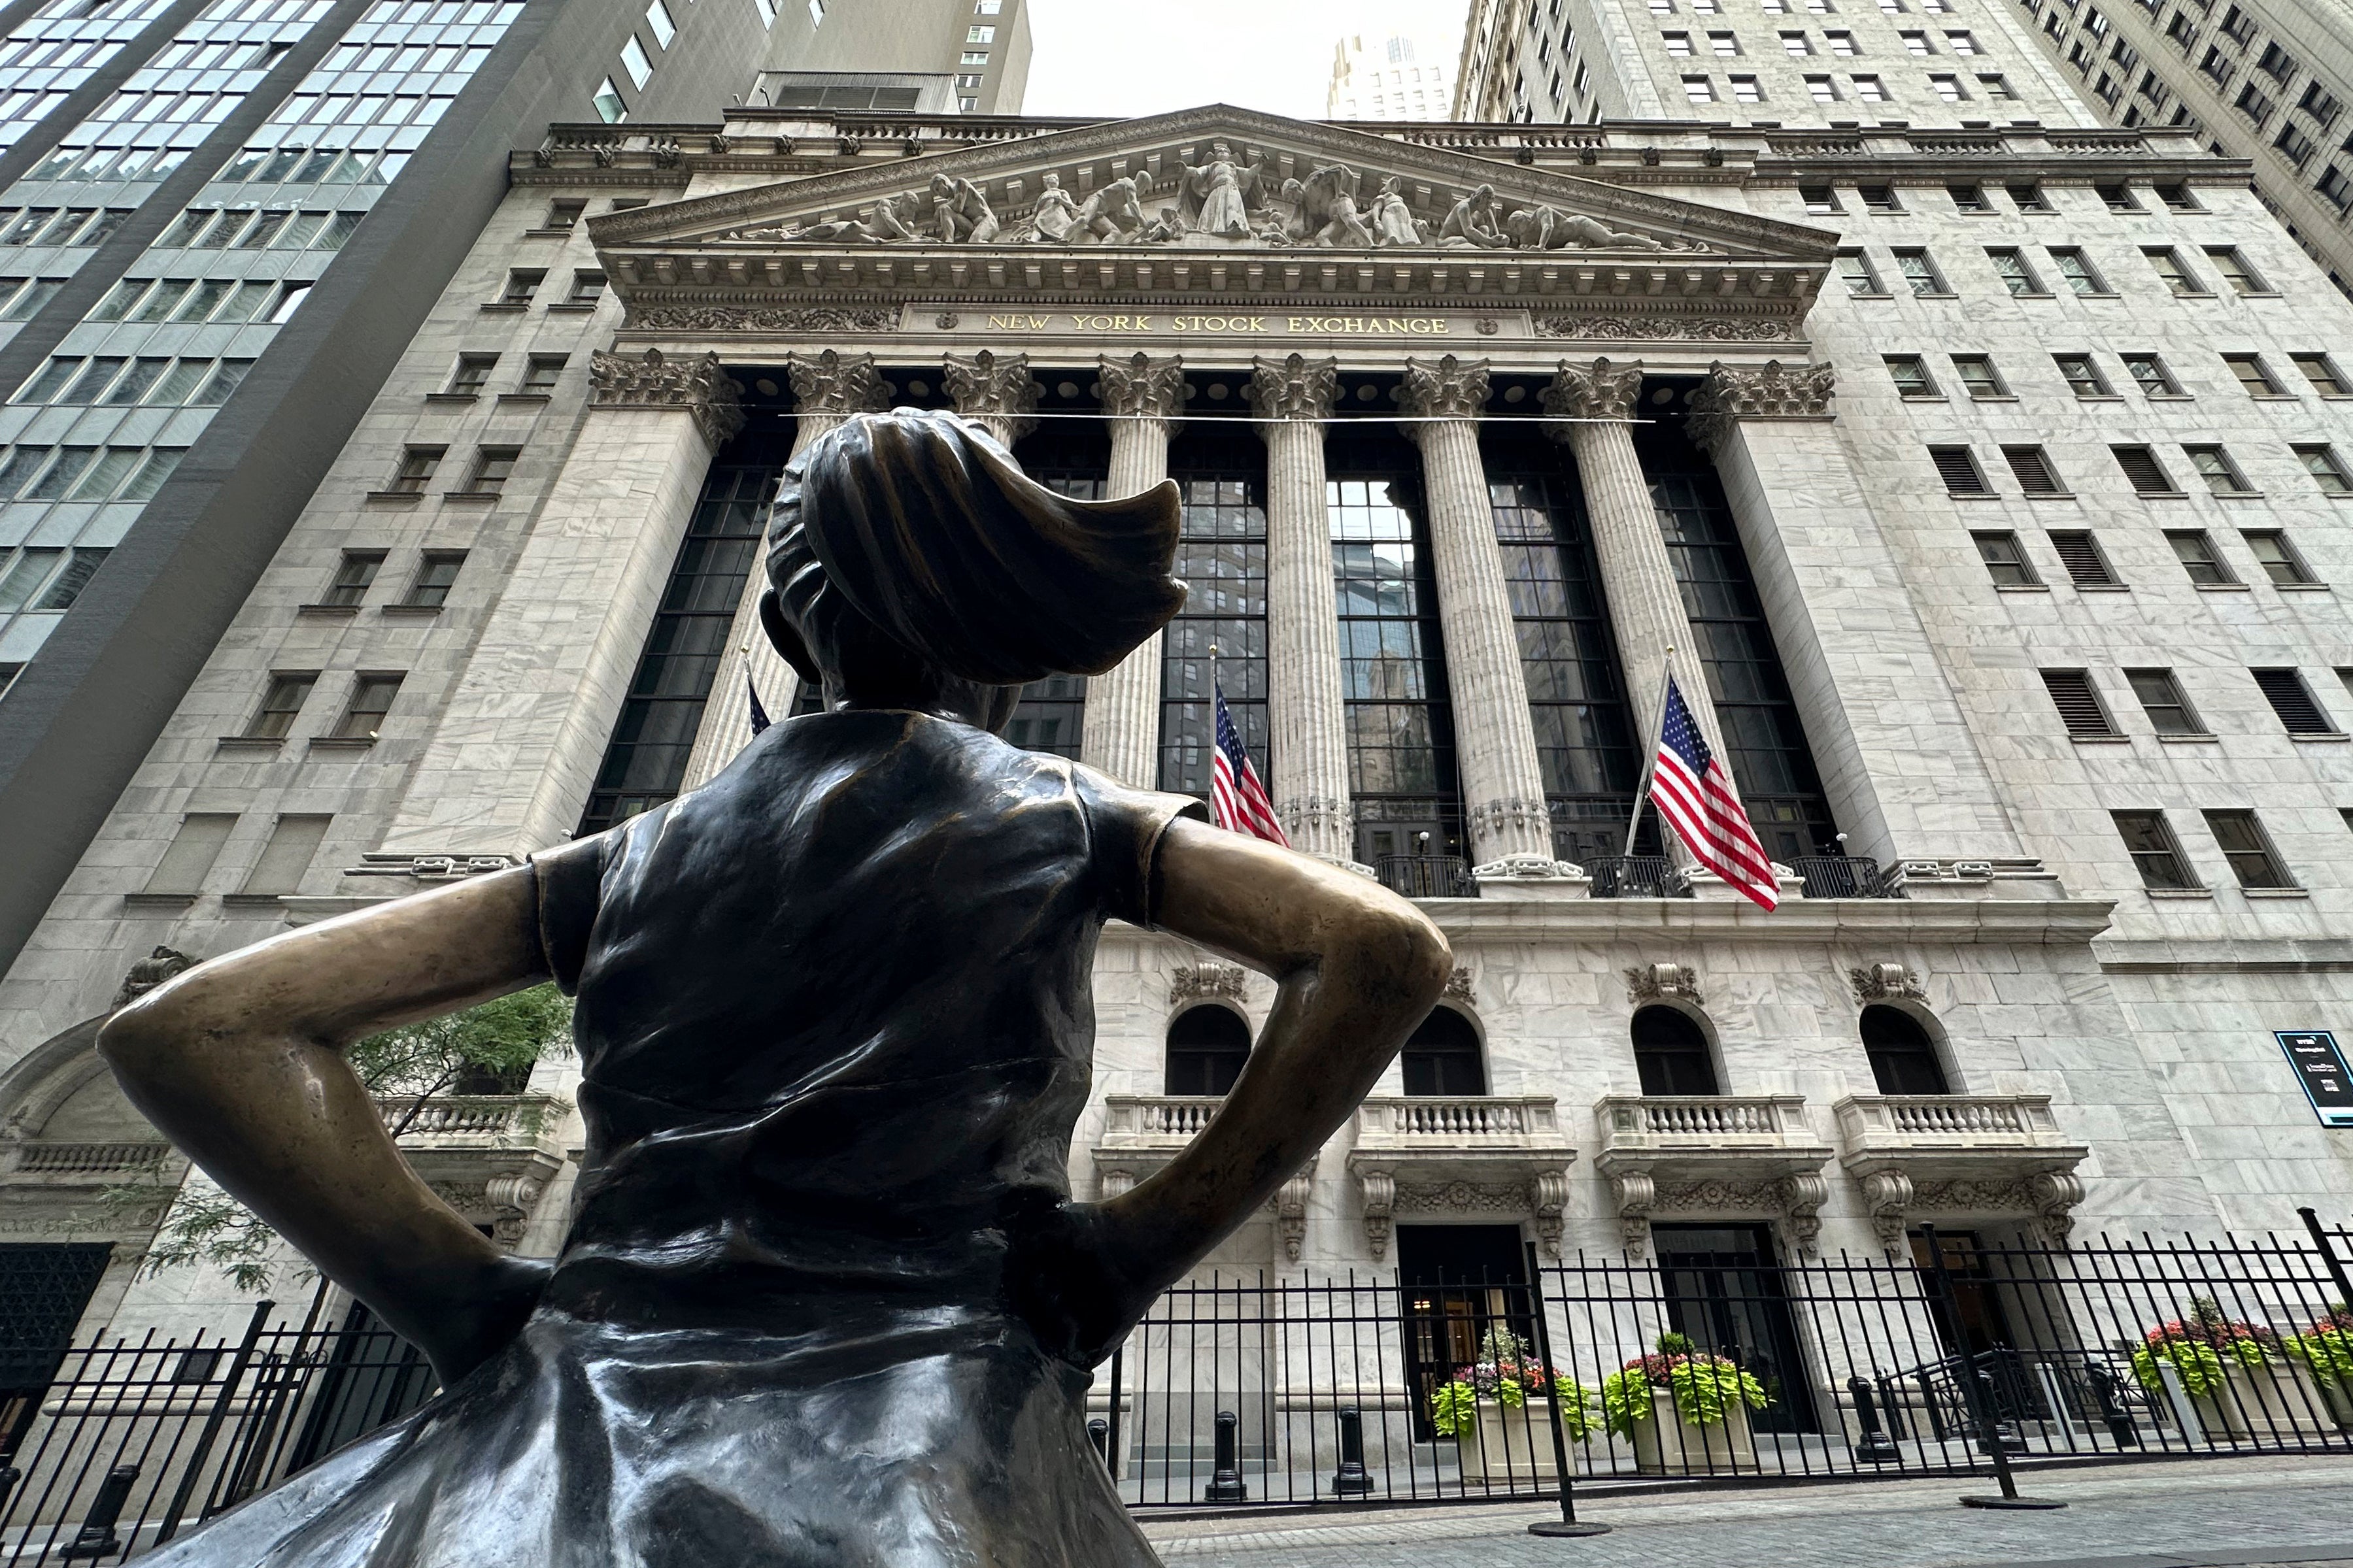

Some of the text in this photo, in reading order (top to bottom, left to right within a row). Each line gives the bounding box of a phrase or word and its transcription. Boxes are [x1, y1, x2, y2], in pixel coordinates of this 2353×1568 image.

[986, 315, 1449, 333] NEW YORK STOCK EXCHANGE
